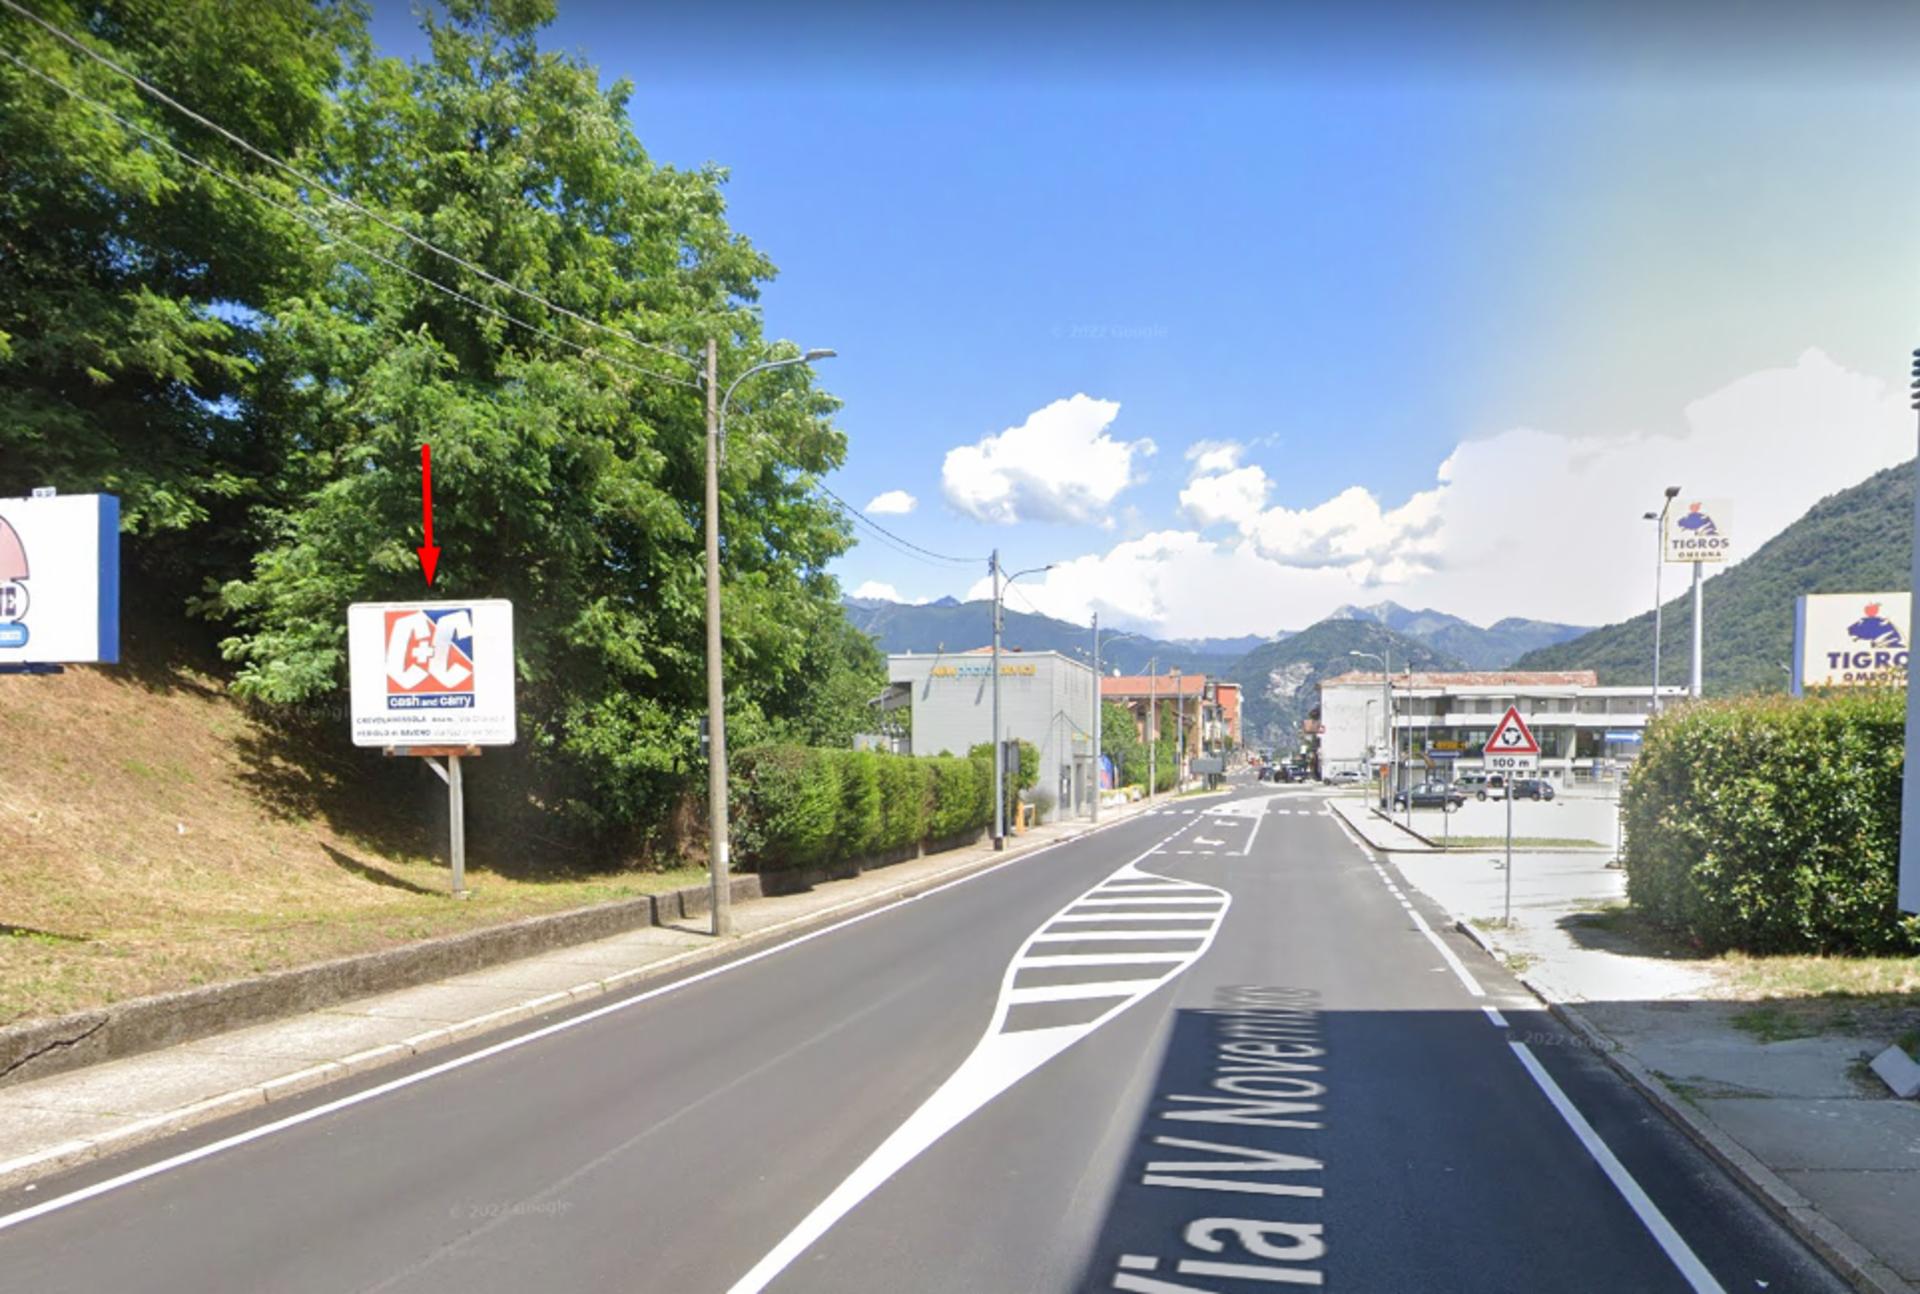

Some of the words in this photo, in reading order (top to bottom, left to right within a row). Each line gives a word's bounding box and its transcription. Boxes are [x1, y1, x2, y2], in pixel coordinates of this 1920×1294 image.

[1672, 538, 1730, 549] TIGROS
[1827, 651, 1910, 670] TIGRO
[1493, 758, 1515, 768] 100
